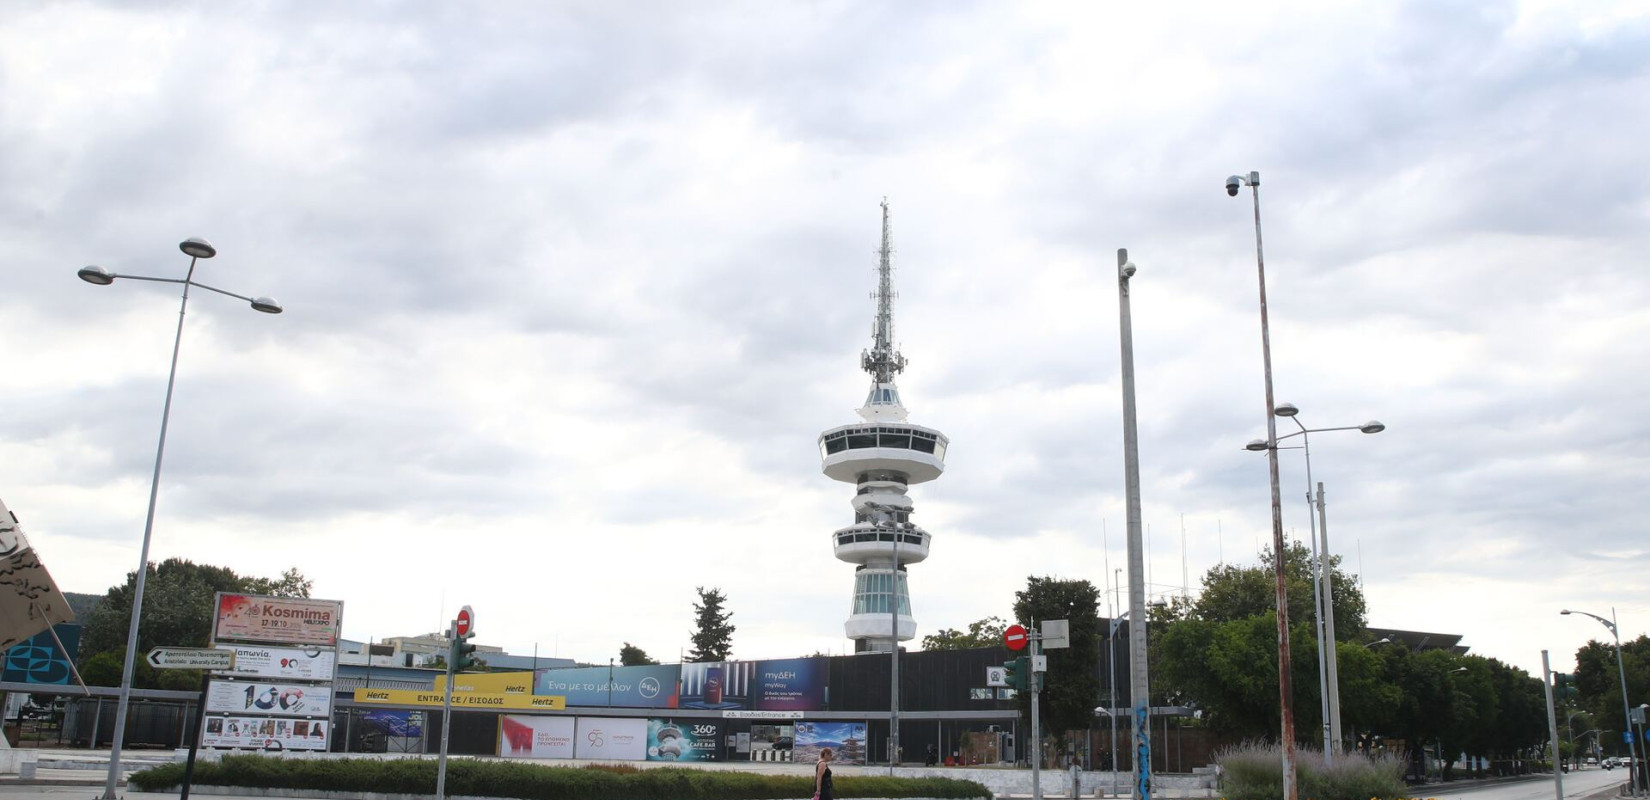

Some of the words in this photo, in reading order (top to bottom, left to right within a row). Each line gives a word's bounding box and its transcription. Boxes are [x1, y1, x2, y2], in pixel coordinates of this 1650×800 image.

[263, 605, 331, 620] Kosmima
[765, 671, 796, 681] myΔΕΗ
[568, 684, 580, 692] με
[641, 682, 657, 692] ΔΕΗ
[366, 691, 389, 699] Hertz
[417, 694, 461, 703] ENTRACE
